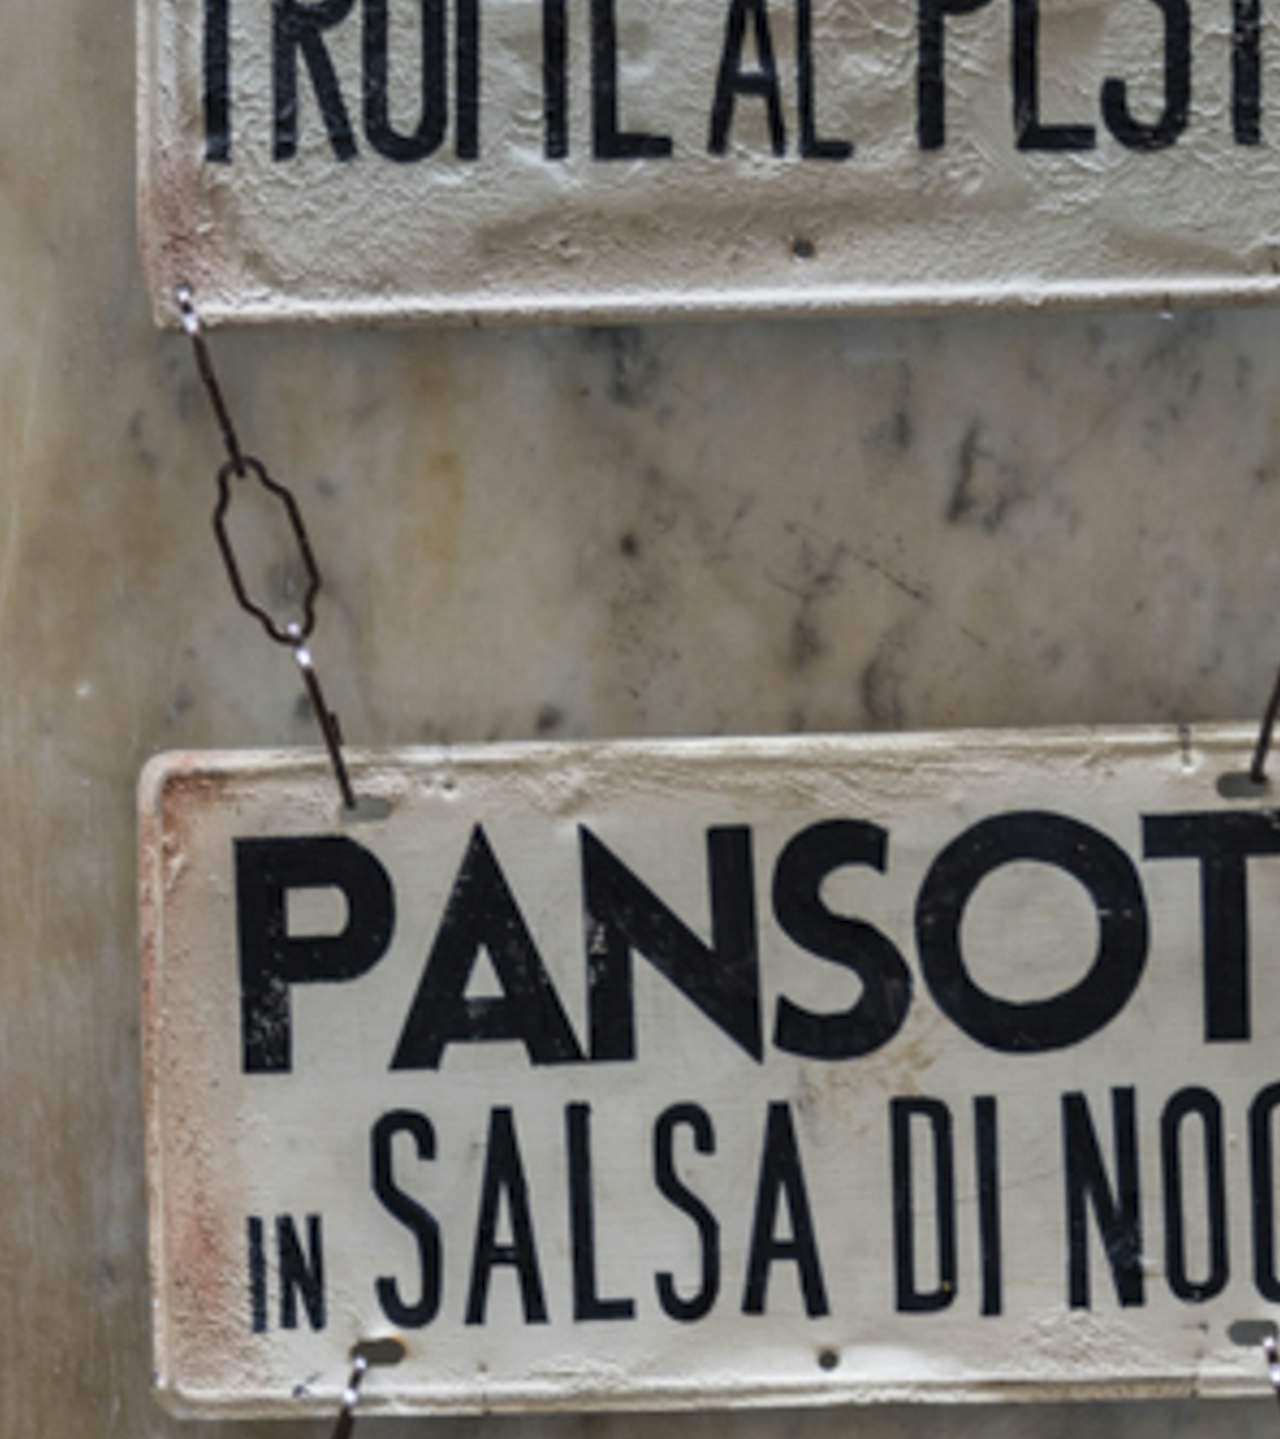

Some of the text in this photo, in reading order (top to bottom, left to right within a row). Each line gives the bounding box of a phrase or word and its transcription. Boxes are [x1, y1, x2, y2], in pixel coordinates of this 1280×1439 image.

[248, 1214, 326, 1333] IN
[371, 1100, 829, 1329] SALSA
[889, 1094, 1002, 1317] DI
